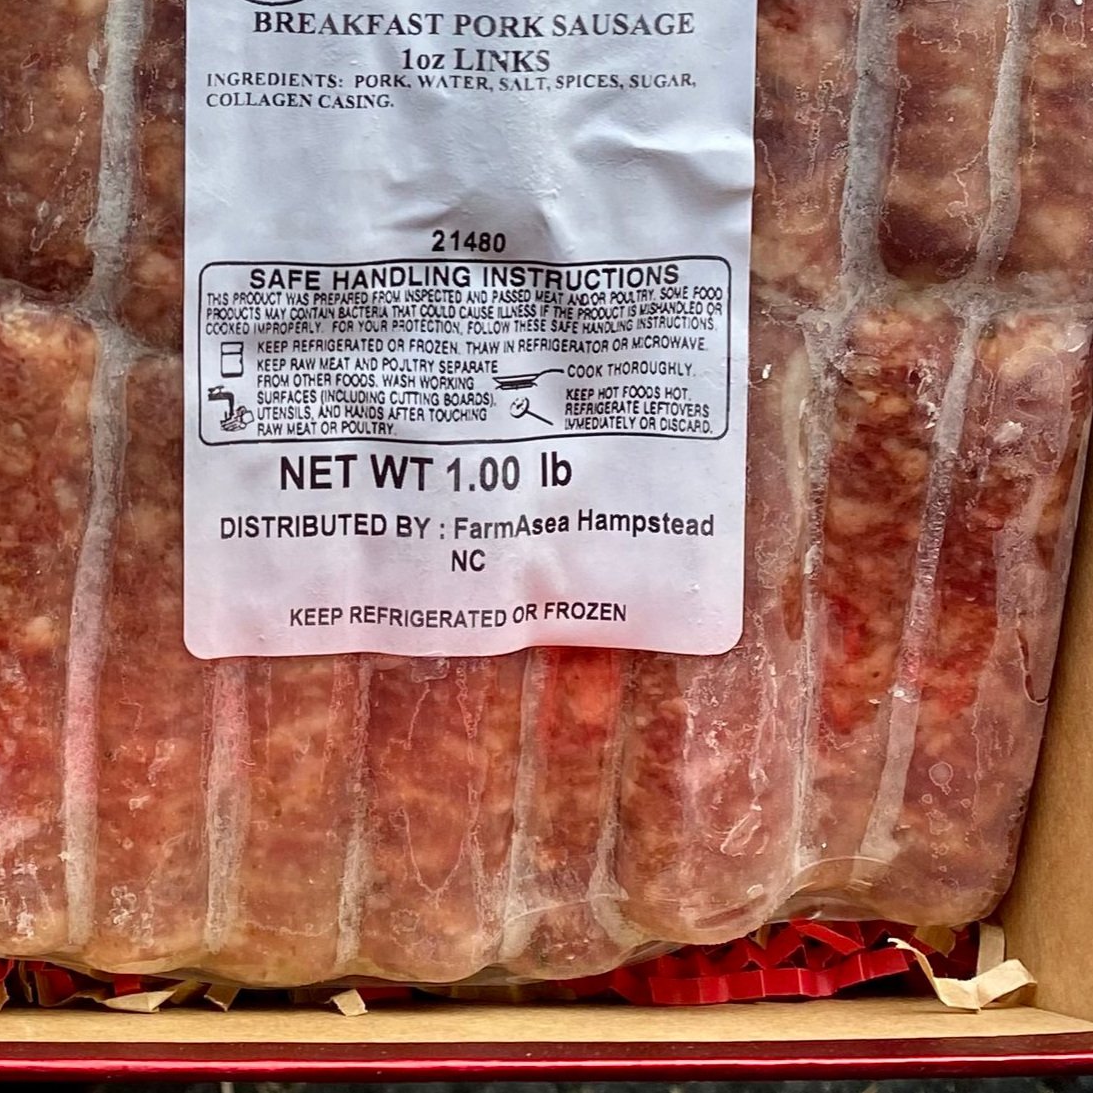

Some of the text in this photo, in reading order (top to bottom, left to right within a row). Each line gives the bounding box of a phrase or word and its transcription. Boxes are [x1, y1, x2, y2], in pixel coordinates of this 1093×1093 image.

[252, 11, 695, 38] BREAKFAST PORK SAUSAGE
[401, 48, 551, 73] 1oz LINKS
[207, 72, 696, 93] INGREDIENTS: WATER, SALT, SPICES, SUGAR,
[206, 93, 395, 109] COLLAGEN CASING.
[431, 230, 507, 254] 21480
[250, 264, 679, 291] SAFE HANDLING INSTRUCTIONS
[233, 292, 282, 306] PRODUCT
[332, 319, 546, 333] FOR YOUR THESE
[258, 337, 628, 354] KEEP REFRIGERATED OR THAW IN REFRIGERATOR OR
[258, 357, 498, 374] KEEP RAW MEAT AND POULTRY SEPARATE
[568, 361, 696, 378] COOK THOROUGHLY.
[258, 373, 474, 390] FROM OTHER WASH WORKING
[257, 390, 439, 406] SURFACES CUTTING
[566, 385, 660, 401] KEEP HOT FOODS
[318, 406, 487, 422] AND HANDS AFTER TOUCHING
[565, 400, 709, 418] REFRIGERATE LEFTOVERS
[258, 421, 337, 436] RAW MEAT OR
[639, 417, 713, 434] OR DISCARD.
[280, 452, 572, 492] NET WT 1.00 lb
[220, 509, 714, 540] DISTRIBUTED BY FarmAsea Hampstead
[451, 550, 485, 572] NC
[290, 601, 625, 628] KEEP REFRIGERATED OR FROZEN
